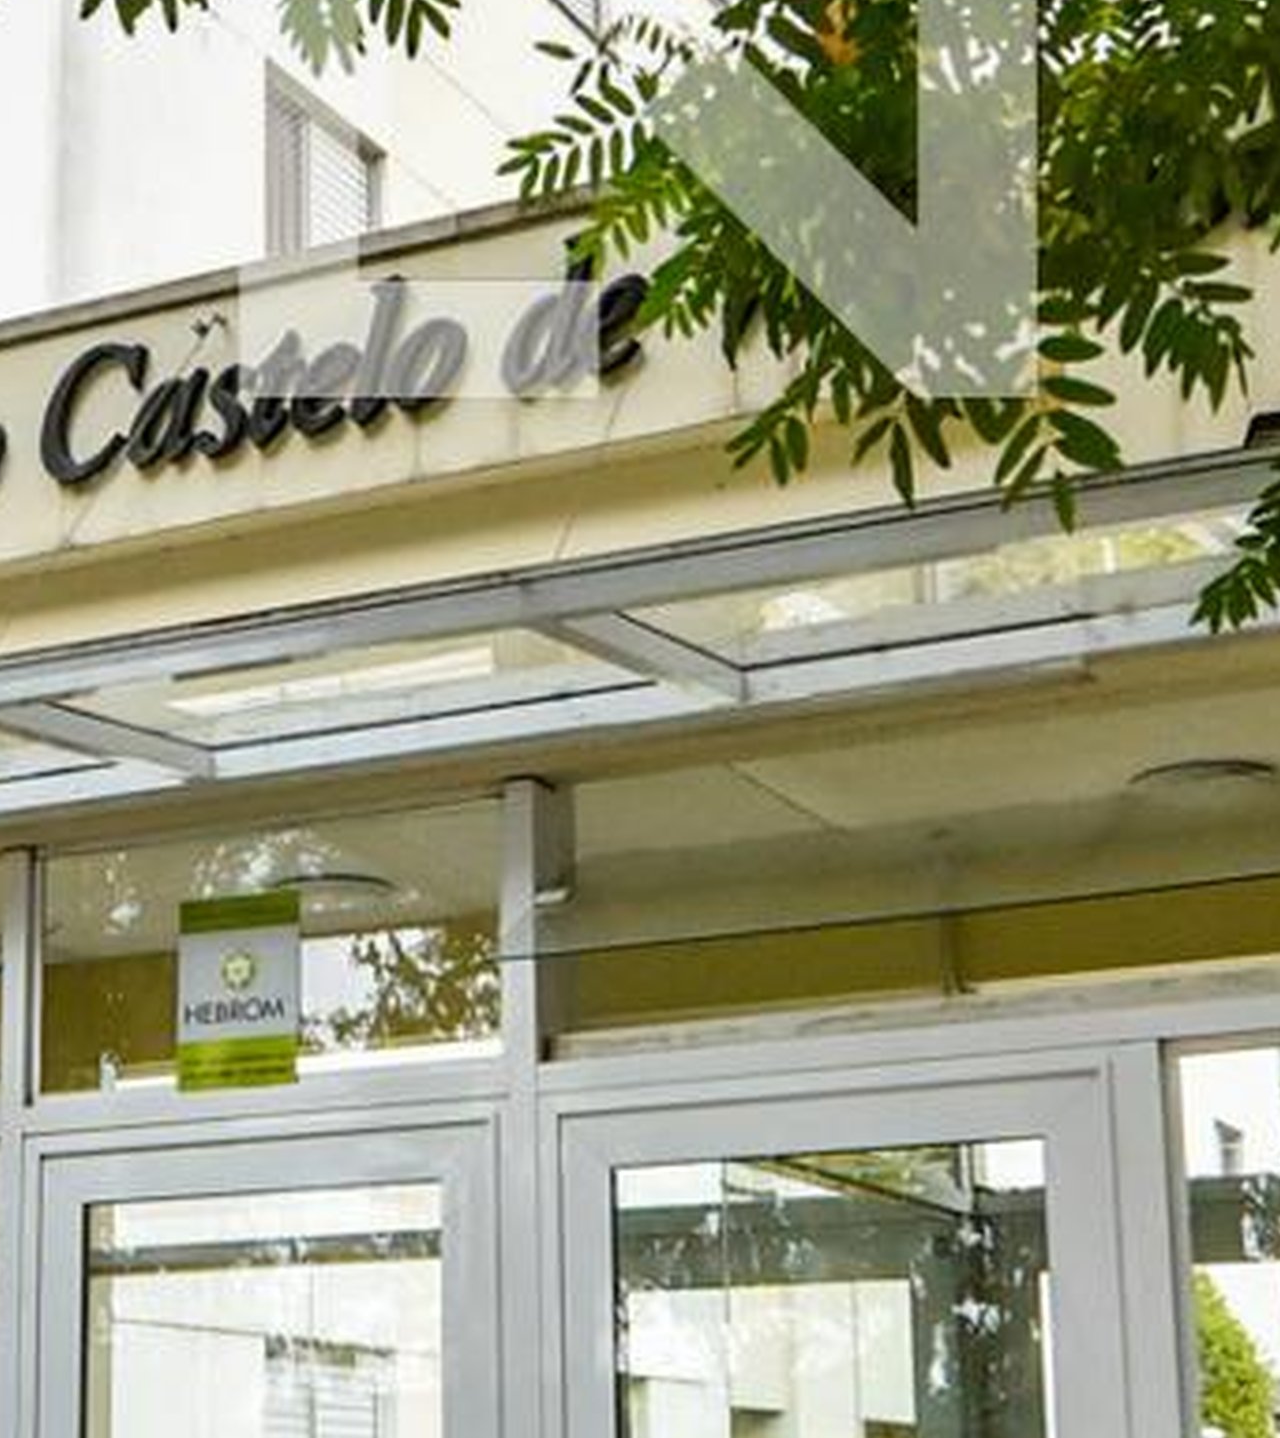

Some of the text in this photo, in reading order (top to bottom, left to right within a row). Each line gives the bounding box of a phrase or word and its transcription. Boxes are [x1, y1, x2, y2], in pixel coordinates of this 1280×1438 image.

[40, 274, 469, 485] Castelo
[502, 234, 650, 401] de
[185, 996, 285, 1025] HEBROM
